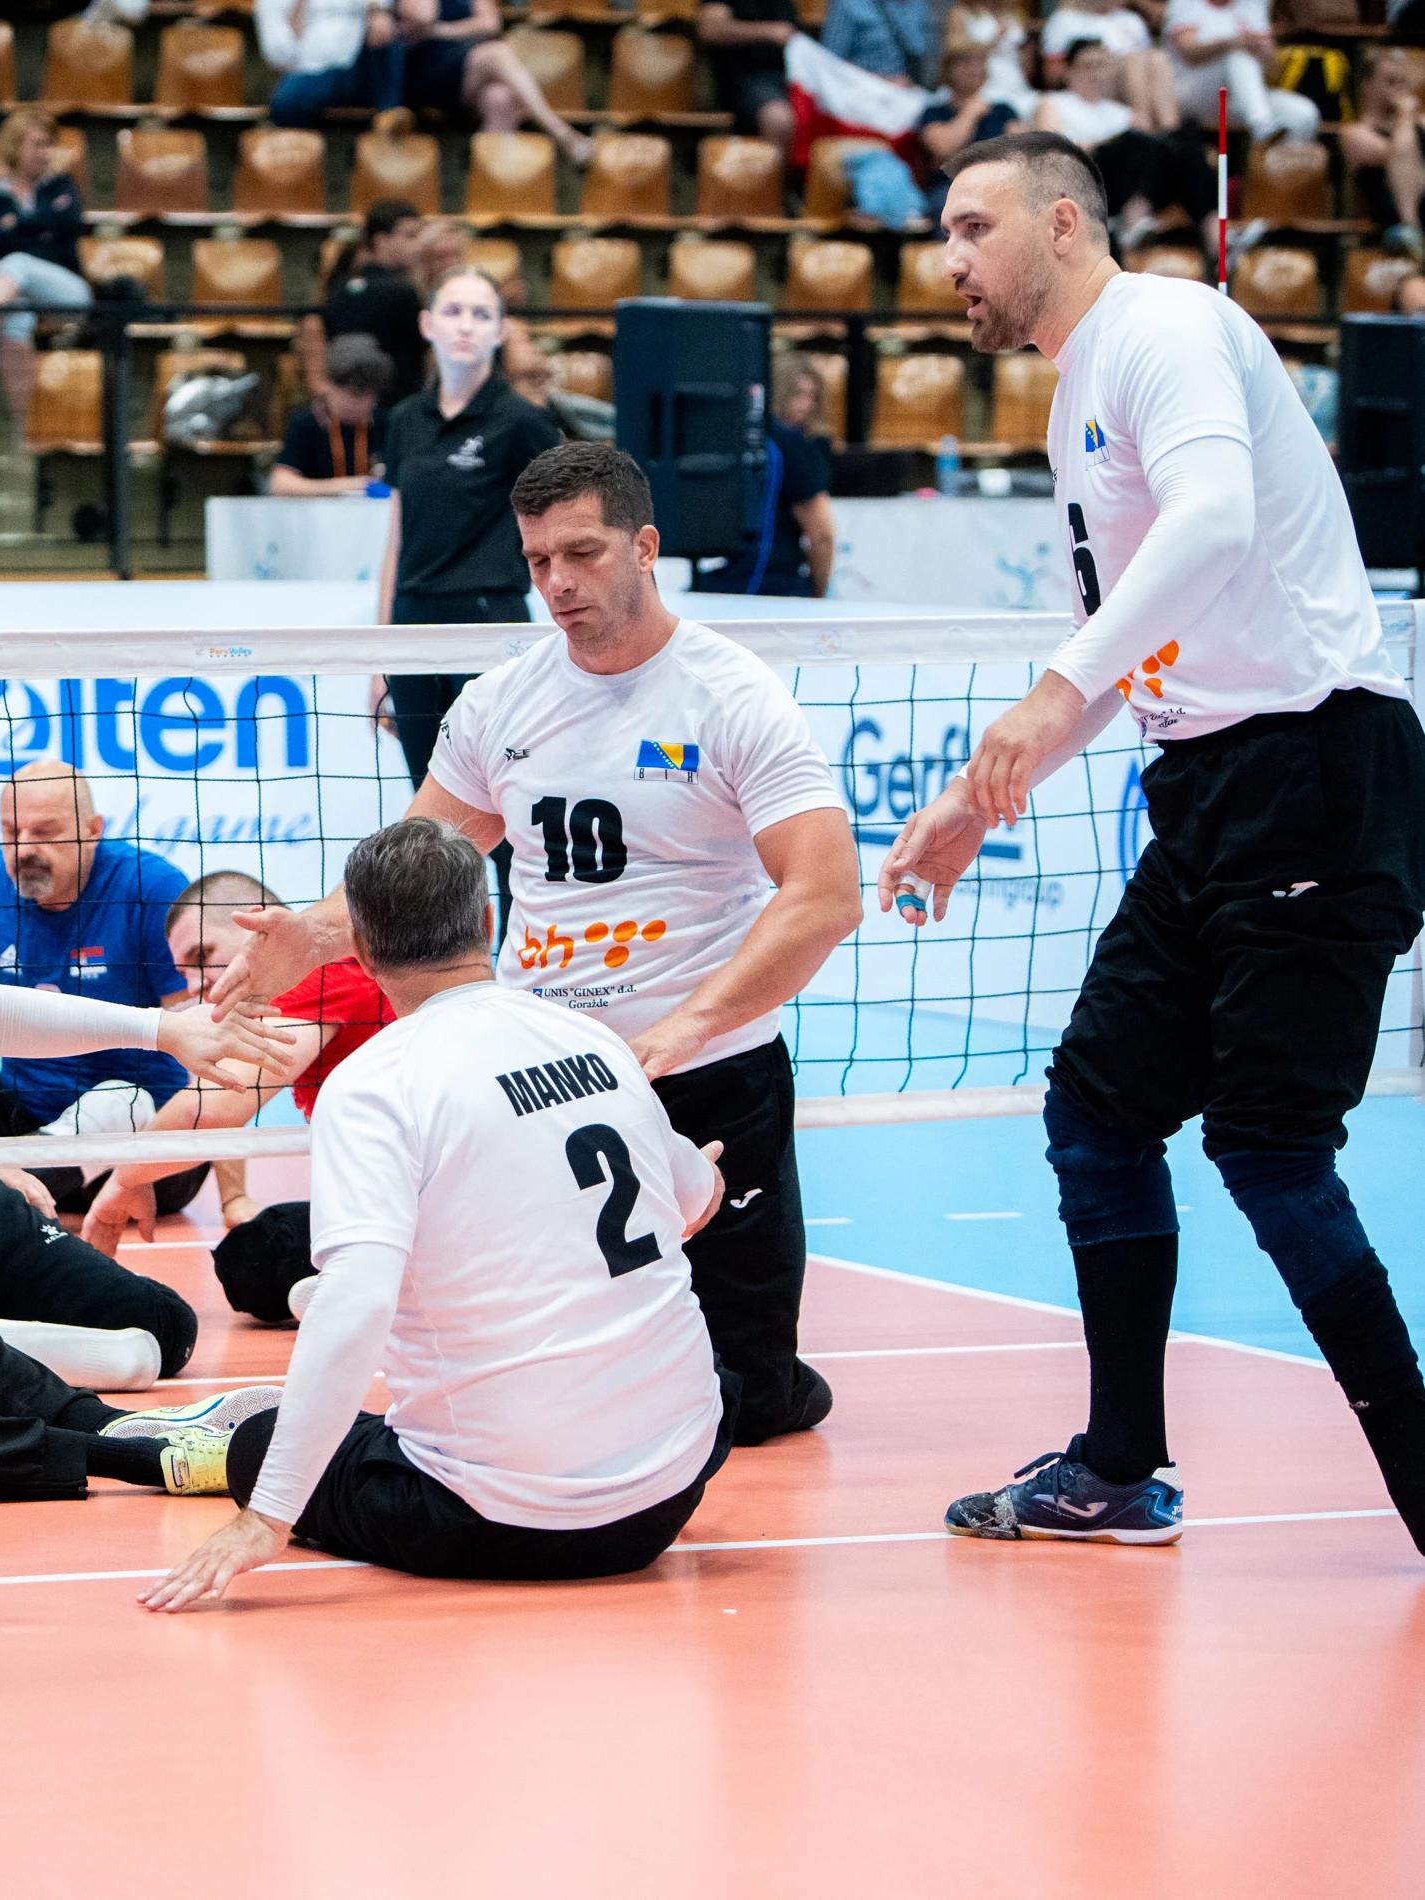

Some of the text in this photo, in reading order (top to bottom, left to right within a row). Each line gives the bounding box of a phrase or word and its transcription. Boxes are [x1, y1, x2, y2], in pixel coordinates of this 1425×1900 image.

[531, 796, 628, 884] 10
[544, 987, 569, 998] UNIS
[495, 1053, 619, 1117] MANKO
[565, 1123, 663, 1279] 2
